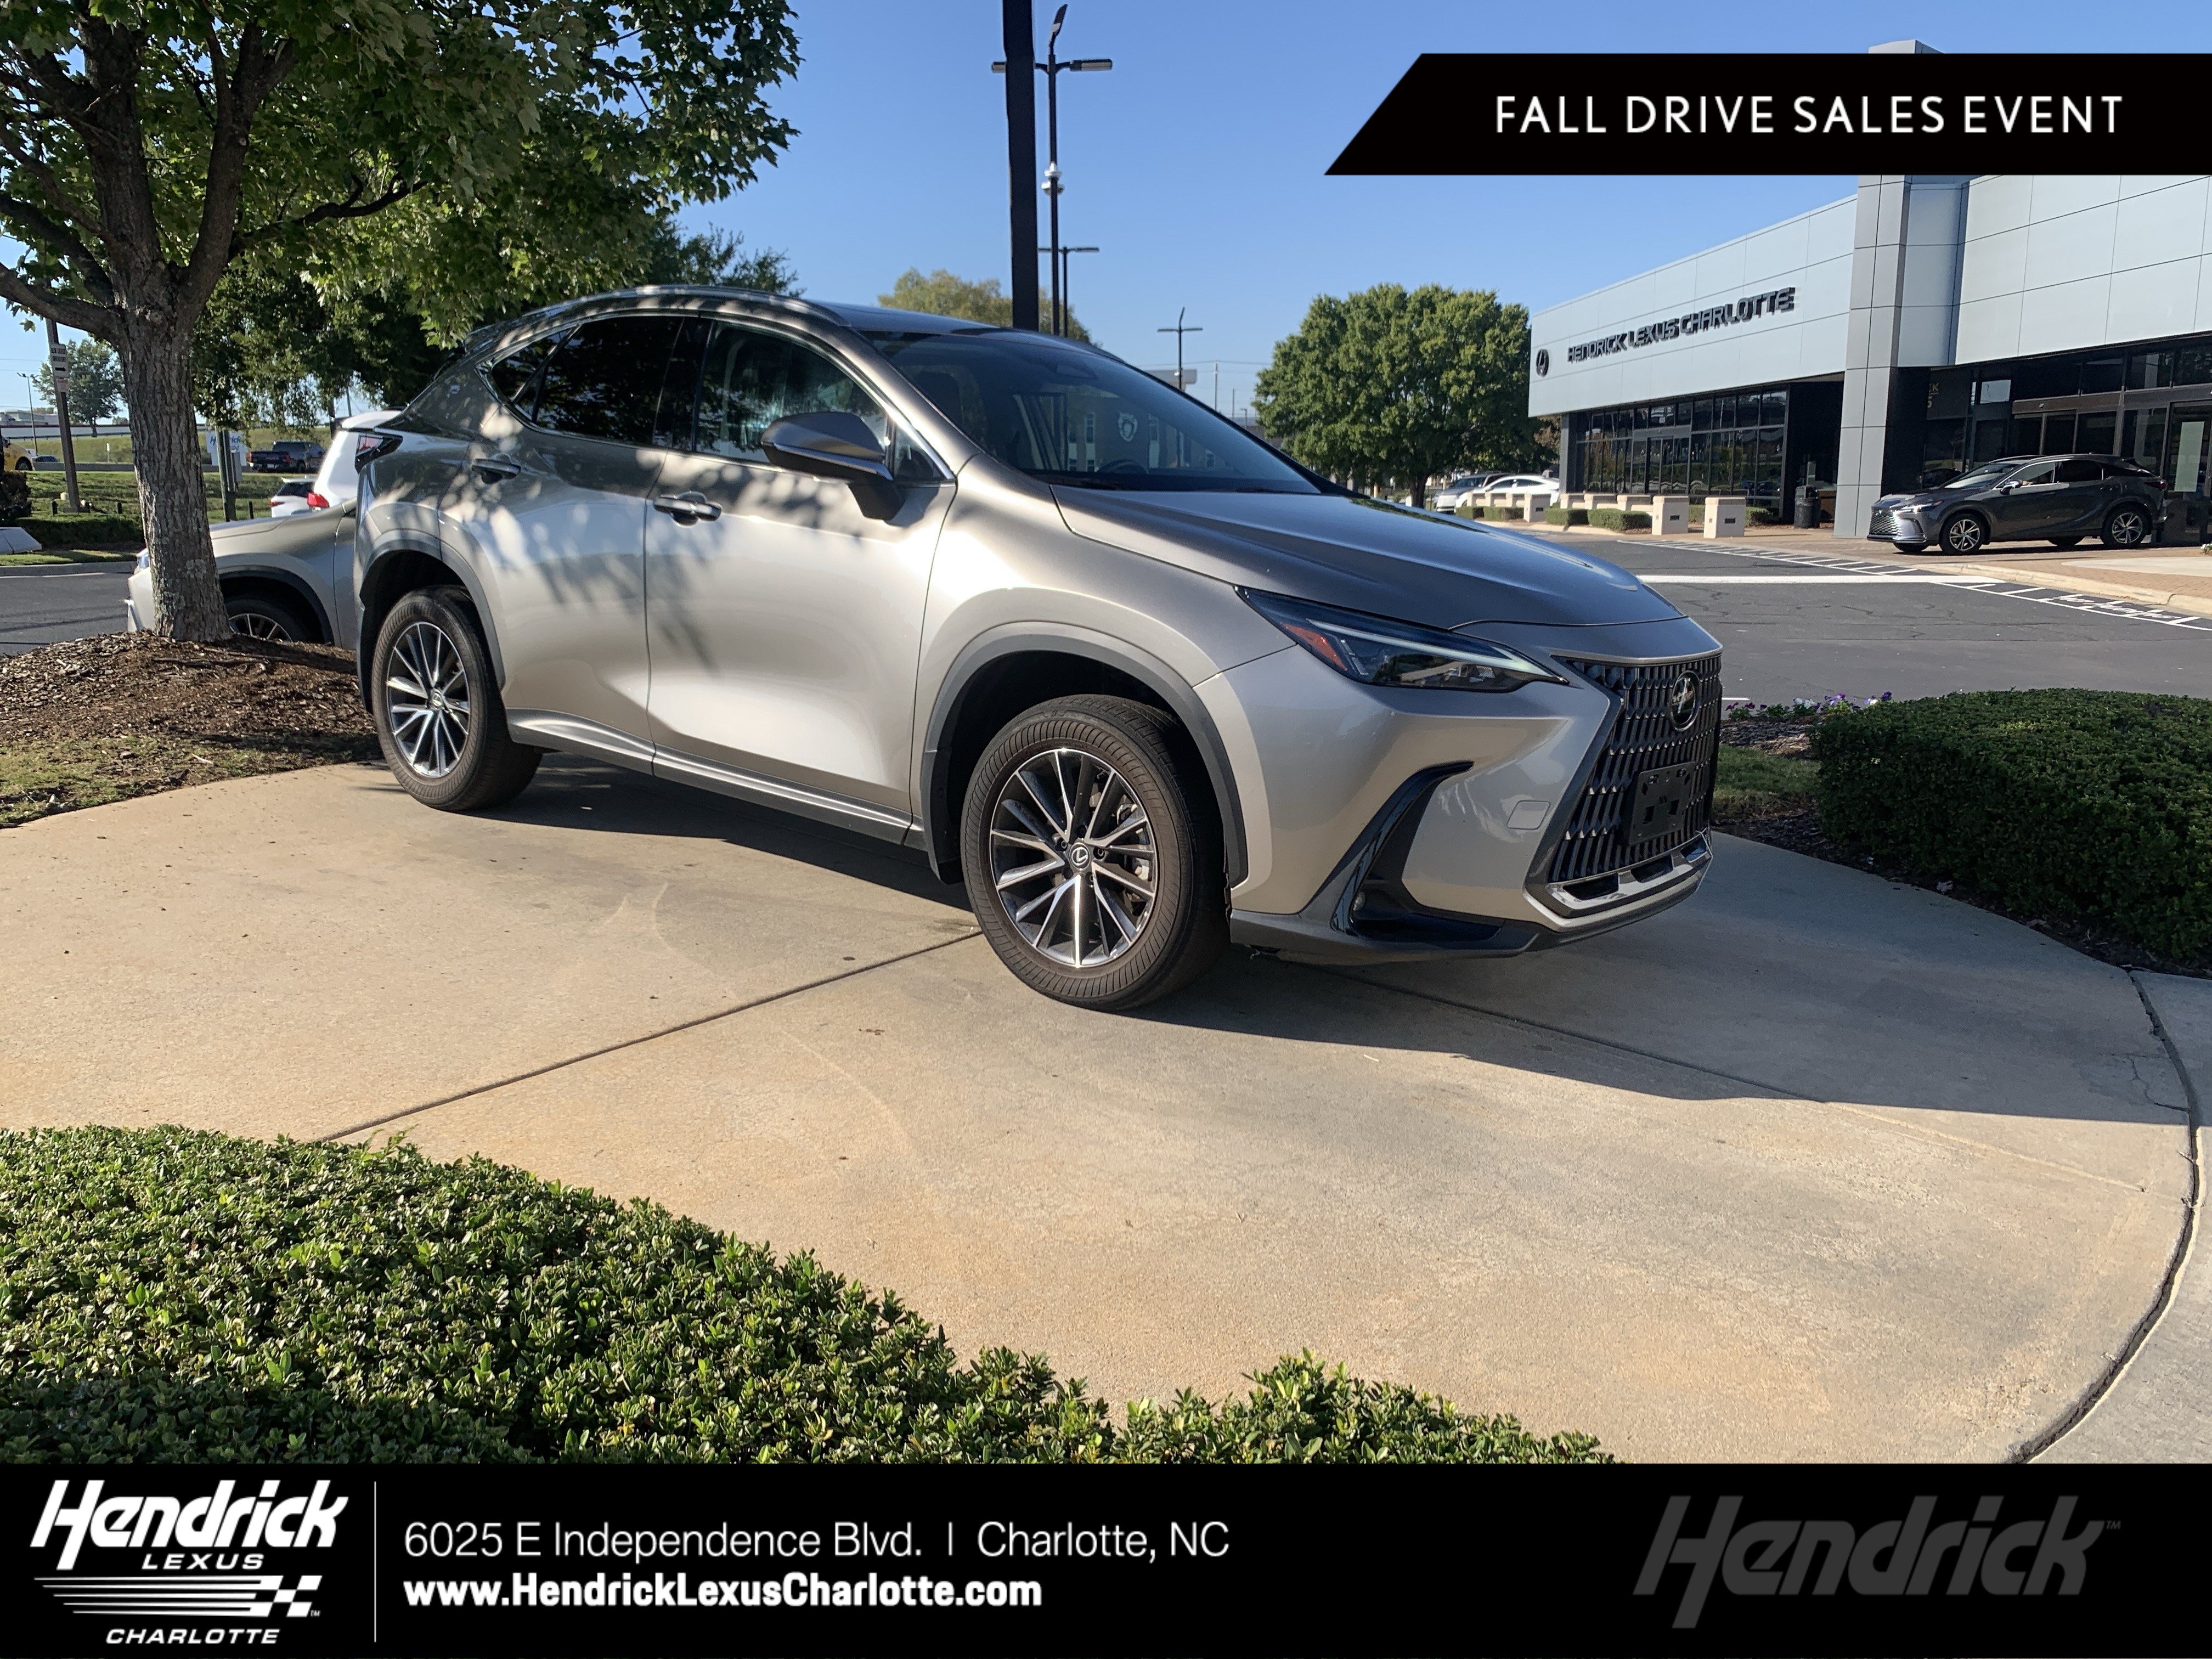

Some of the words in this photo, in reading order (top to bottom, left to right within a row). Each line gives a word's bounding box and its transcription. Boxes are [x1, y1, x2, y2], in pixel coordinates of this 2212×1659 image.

[1567, 332, 1628, 363] HENDRICK
[1628, 318, 1680, 348] LEXUS
[1680, 287, 1796, 335] CHARLOTTE
